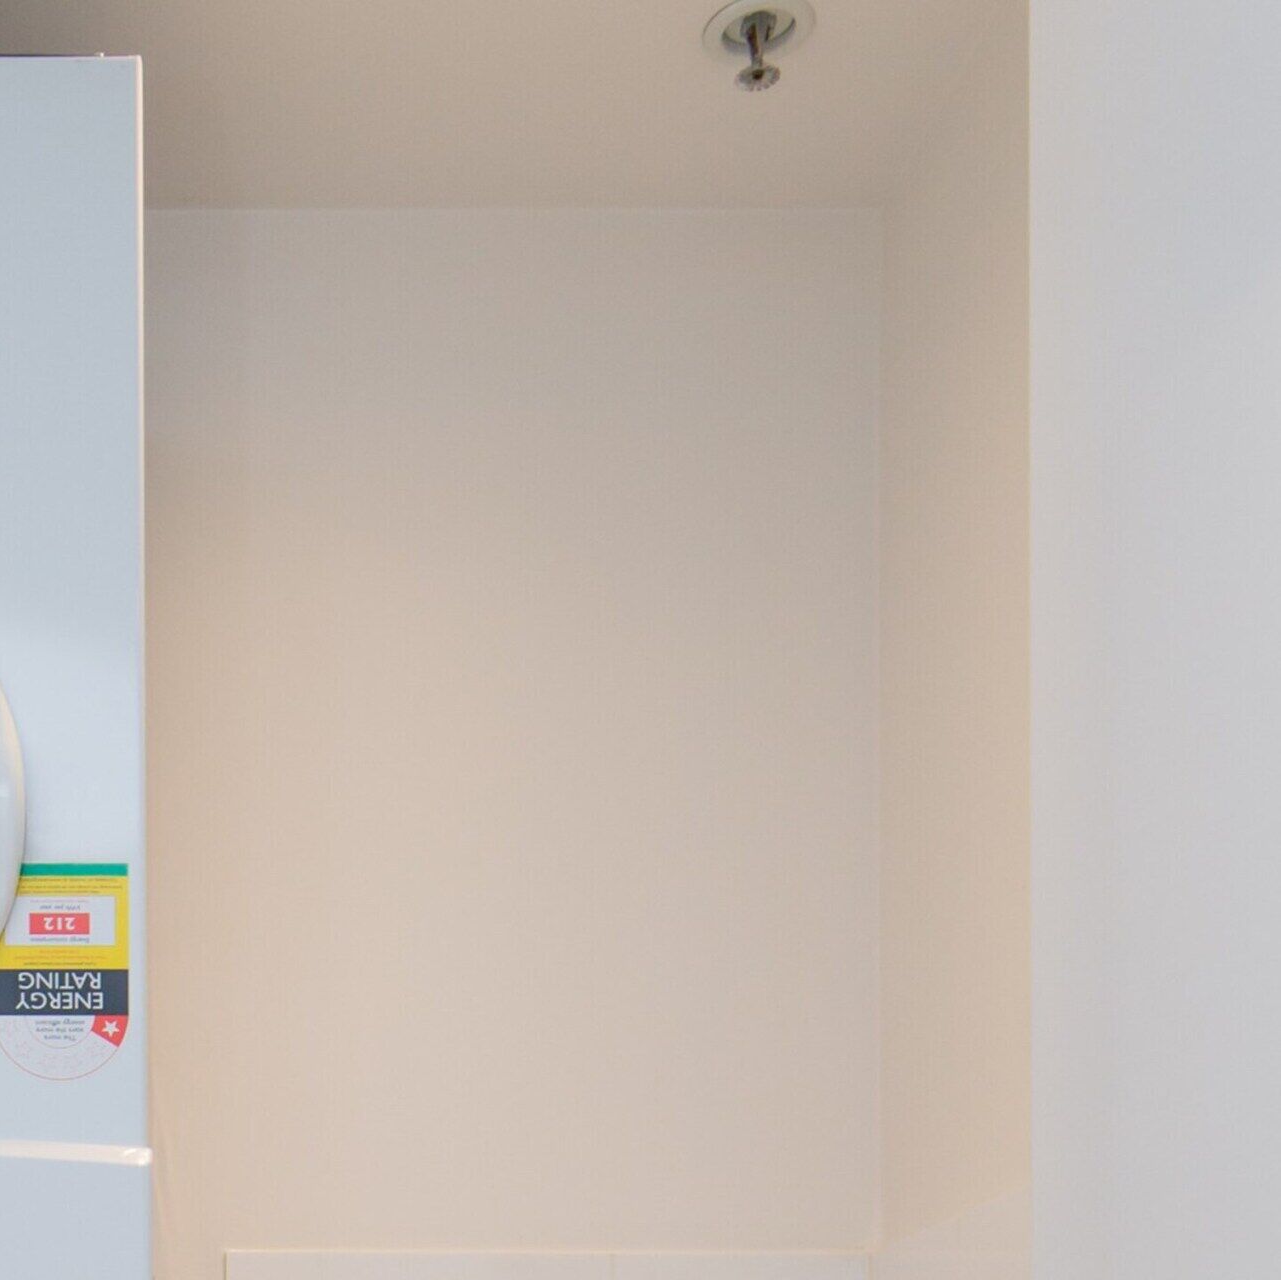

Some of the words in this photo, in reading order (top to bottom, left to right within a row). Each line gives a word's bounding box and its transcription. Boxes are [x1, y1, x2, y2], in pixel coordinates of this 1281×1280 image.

[43, 916, 76, 931] 212
[18, 972, 102, 990] RATING
[15, 992, 104, 1010] ENERGY
